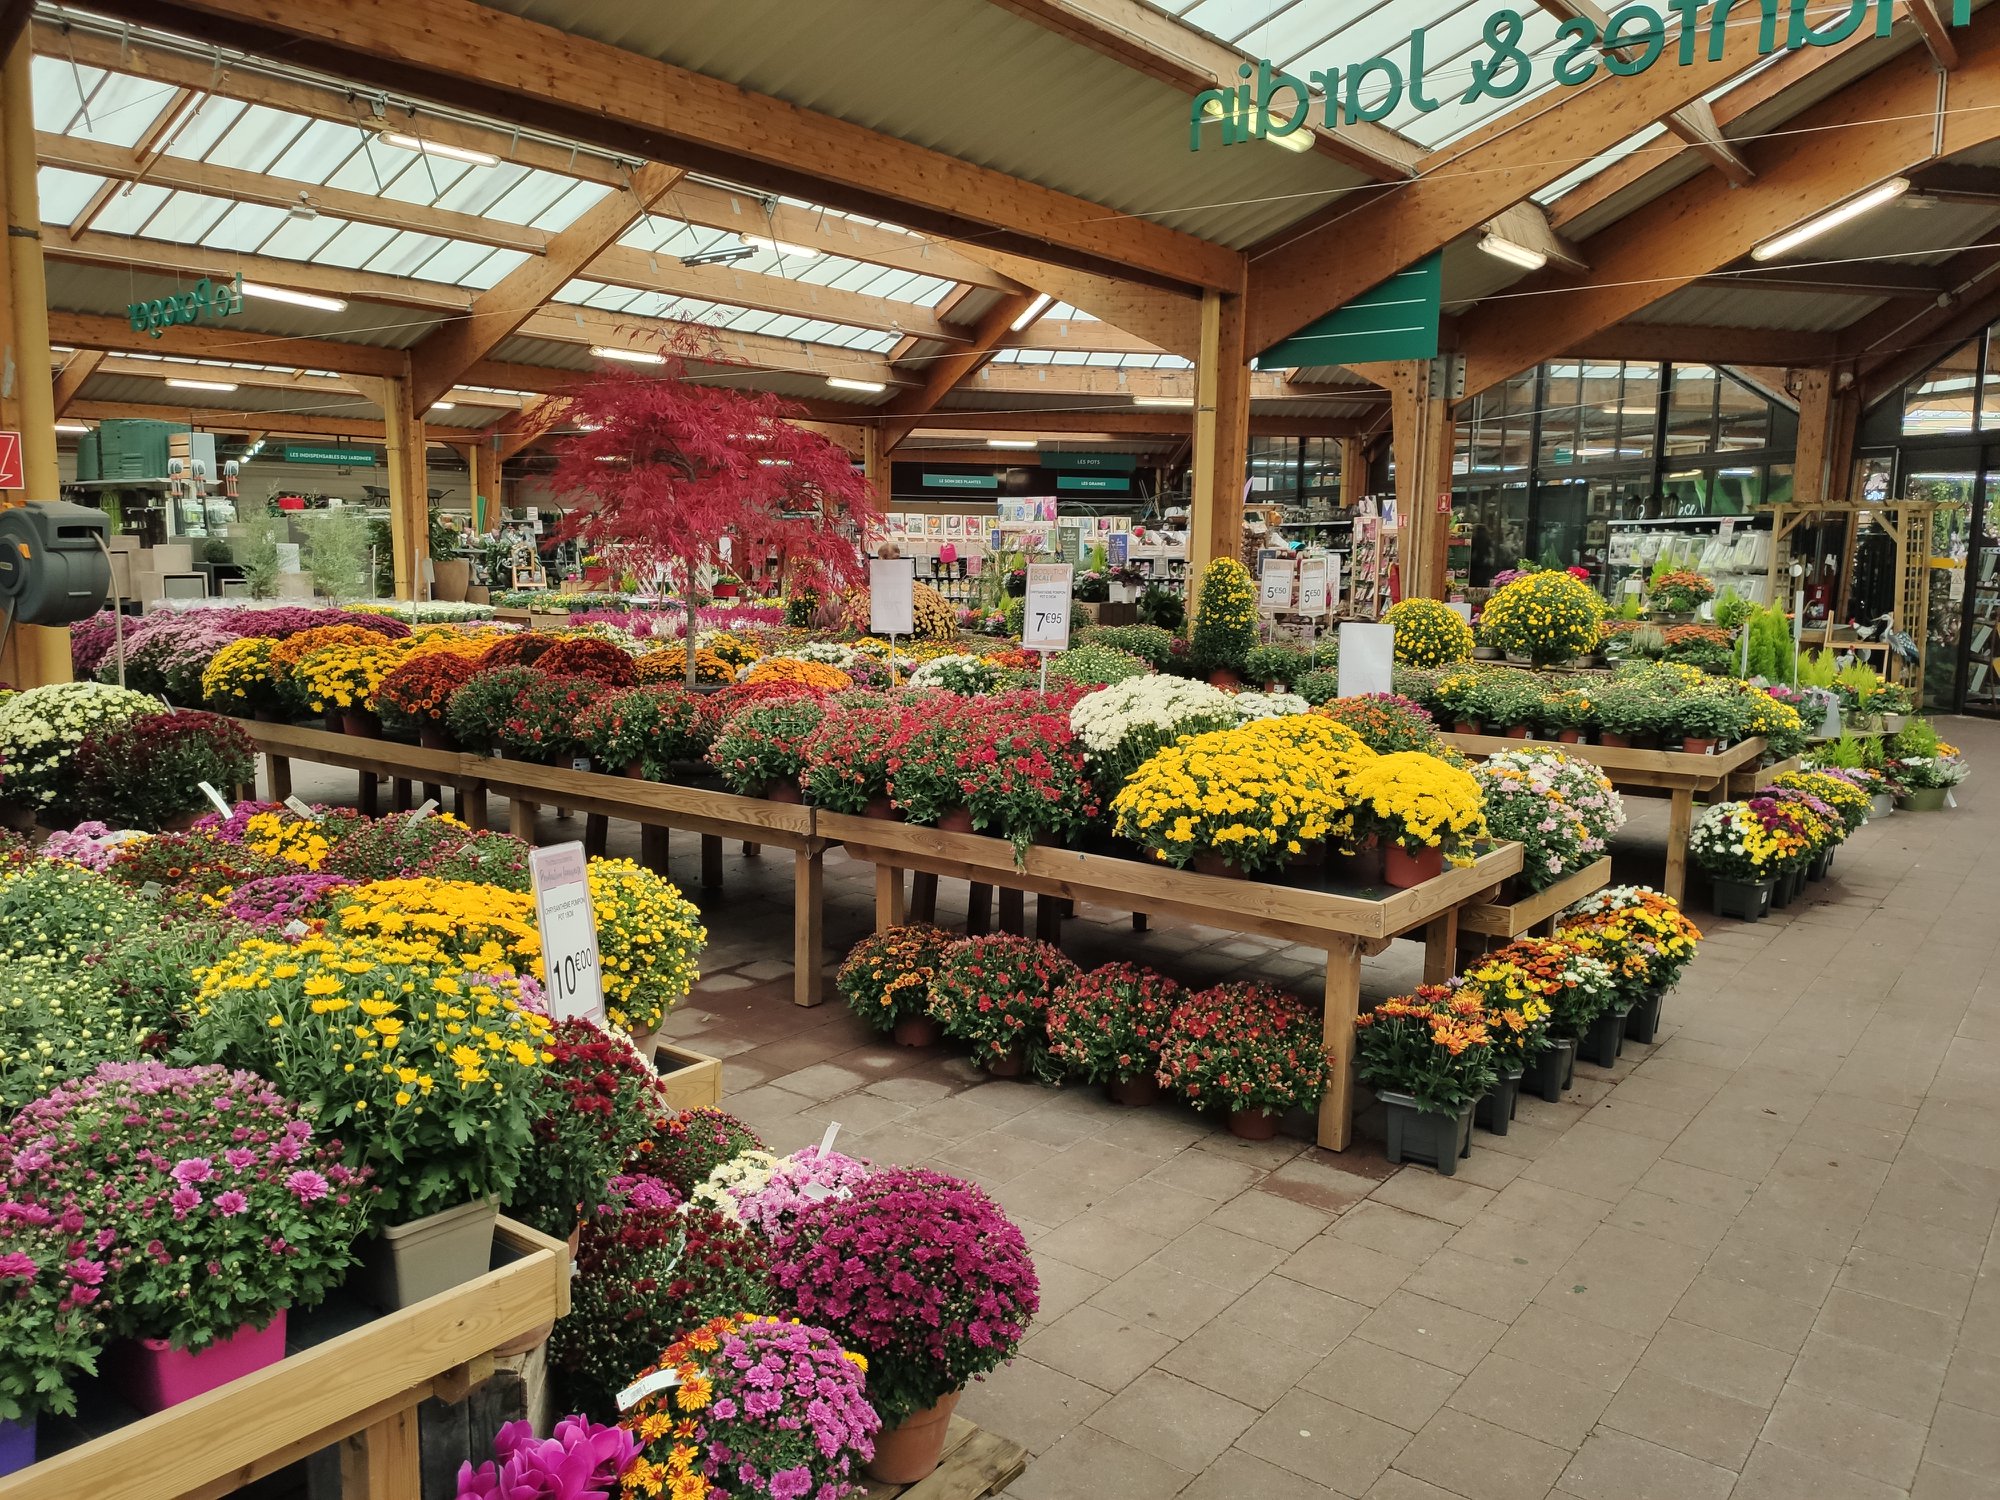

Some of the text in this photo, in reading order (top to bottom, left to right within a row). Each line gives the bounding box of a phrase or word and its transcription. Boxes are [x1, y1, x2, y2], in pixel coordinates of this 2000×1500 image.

[299, 452, 340, 460] INDISPENSABLES
[1267, 586, 1287, 599] 5€50
[1304, 589, 1321, 603] 5€50
[1036, 612, 1062, 633] 7€95
[553, 947, 592, 1000] 10€00
